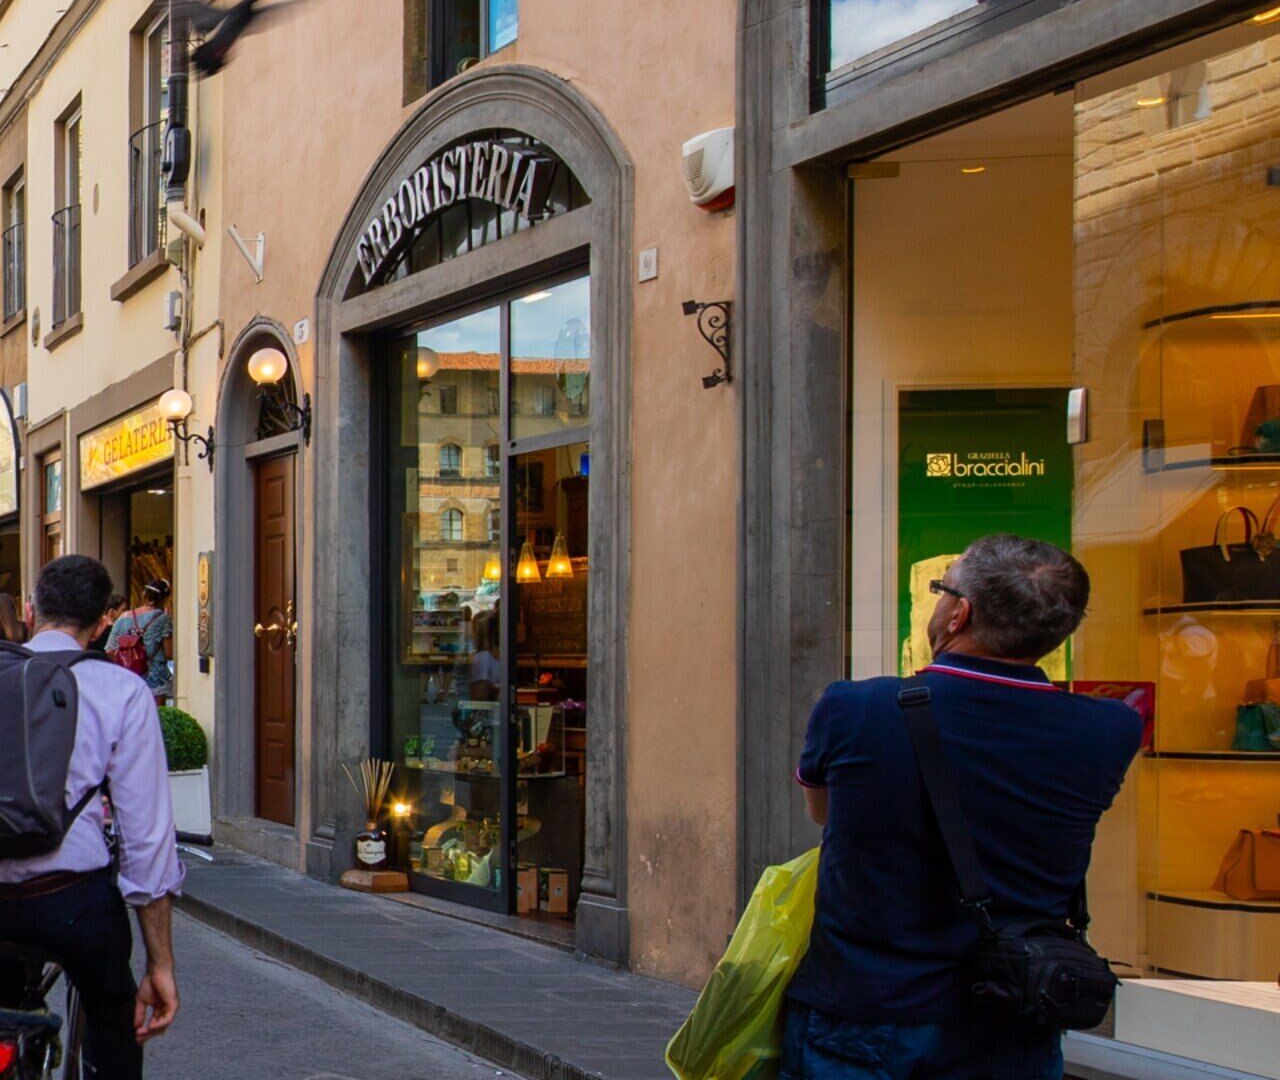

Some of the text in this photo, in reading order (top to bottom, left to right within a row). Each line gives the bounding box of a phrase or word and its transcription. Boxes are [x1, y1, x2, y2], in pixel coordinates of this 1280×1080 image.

[356, 141, 538, 286] ERBORISTERIA
[953, 451, 1045, 477] braccialini
[967, 452, 1011, 460] GRAZIELLA
